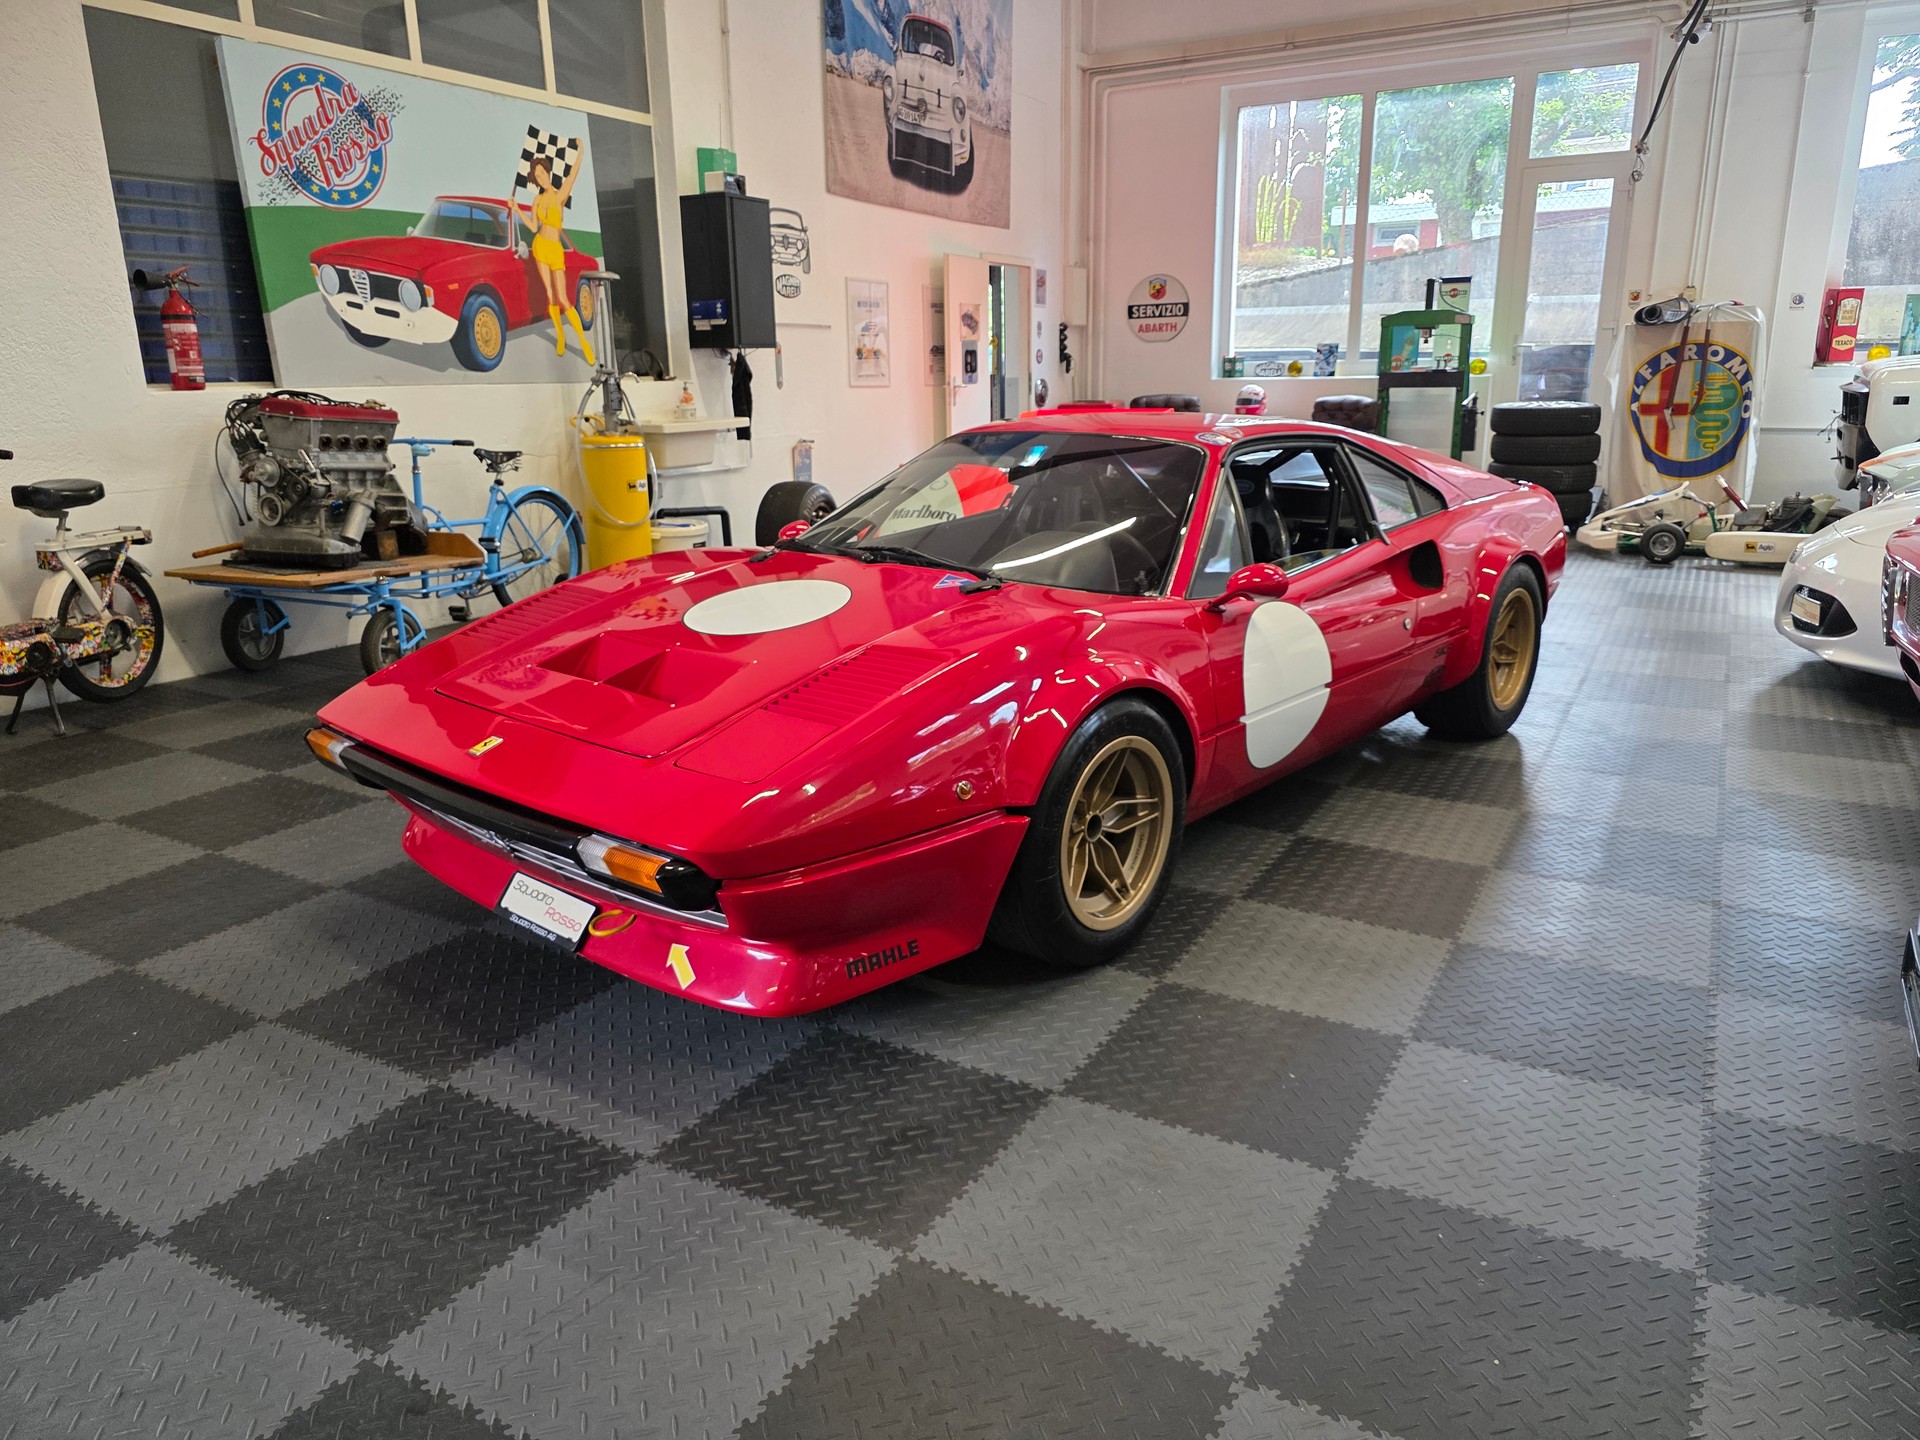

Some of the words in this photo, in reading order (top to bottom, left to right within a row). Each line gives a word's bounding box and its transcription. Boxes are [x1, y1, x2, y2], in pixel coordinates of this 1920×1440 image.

[249, 82, 359, 177] Squadra
[311, 112, 391, 189] Rosso
[1132, 304, 1184, 318] SERVIZIO
[1138, 322, 1178, 333] ABARTH
[1683, 343, 1753, 419] ROMEO
[889, 504, 958, 521] Marlboro
[1758, 543, 1774, 551] Agip
[544, 906, 582, 932] ROSSO
[547, 932, 557, 941] AG
[846, 939, 920, 979] MAHLE
